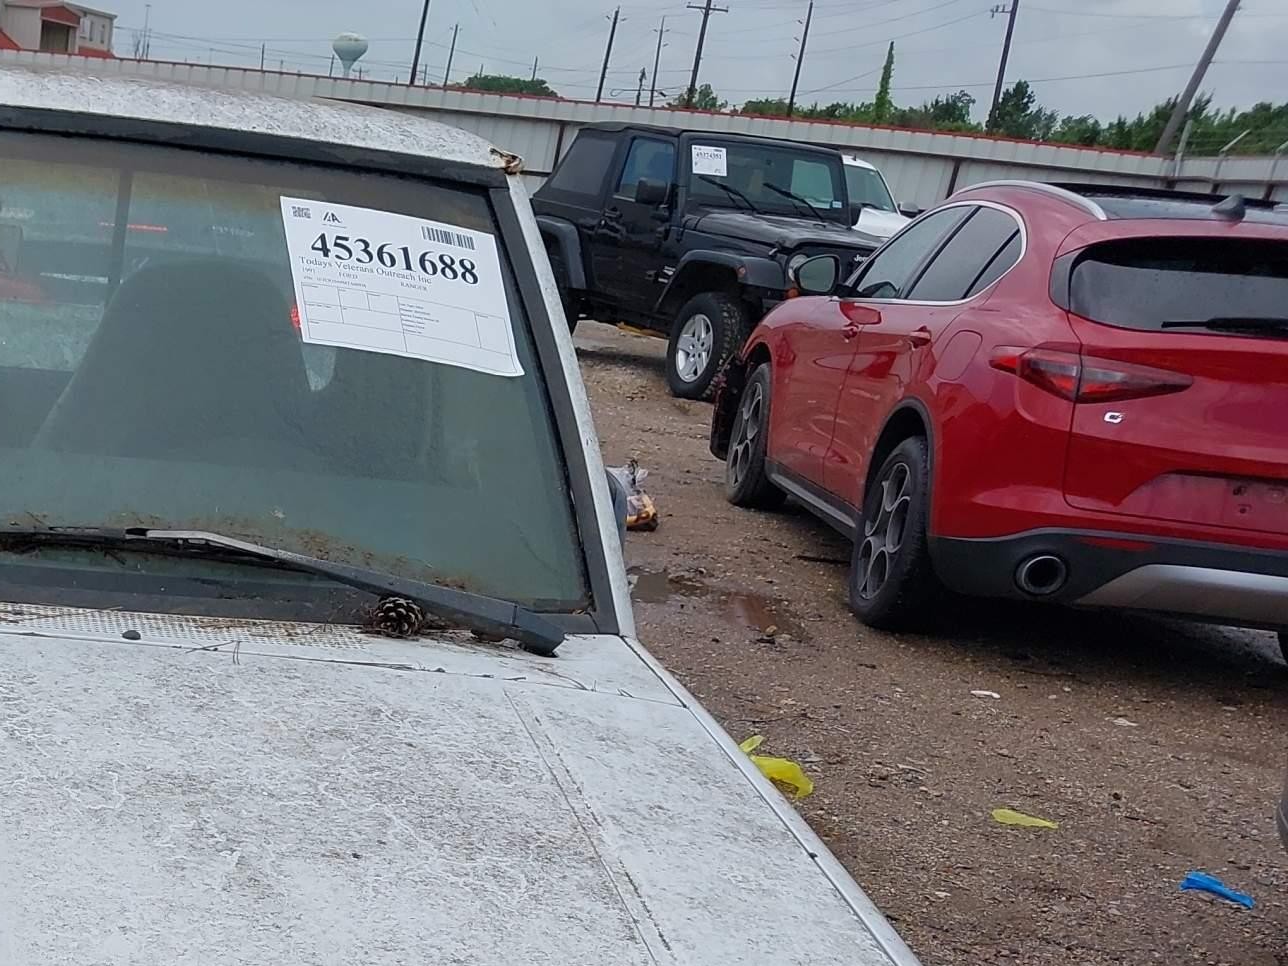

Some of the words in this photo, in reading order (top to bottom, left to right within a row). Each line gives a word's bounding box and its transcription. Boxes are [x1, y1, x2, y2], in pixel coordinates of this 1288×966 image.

[300, 256, 332, 269] Todays
[335, 261, 374, 274] Veterans
[376, 267, 416, 282] Outreach
[310, 232, 479, 285] 45361688
